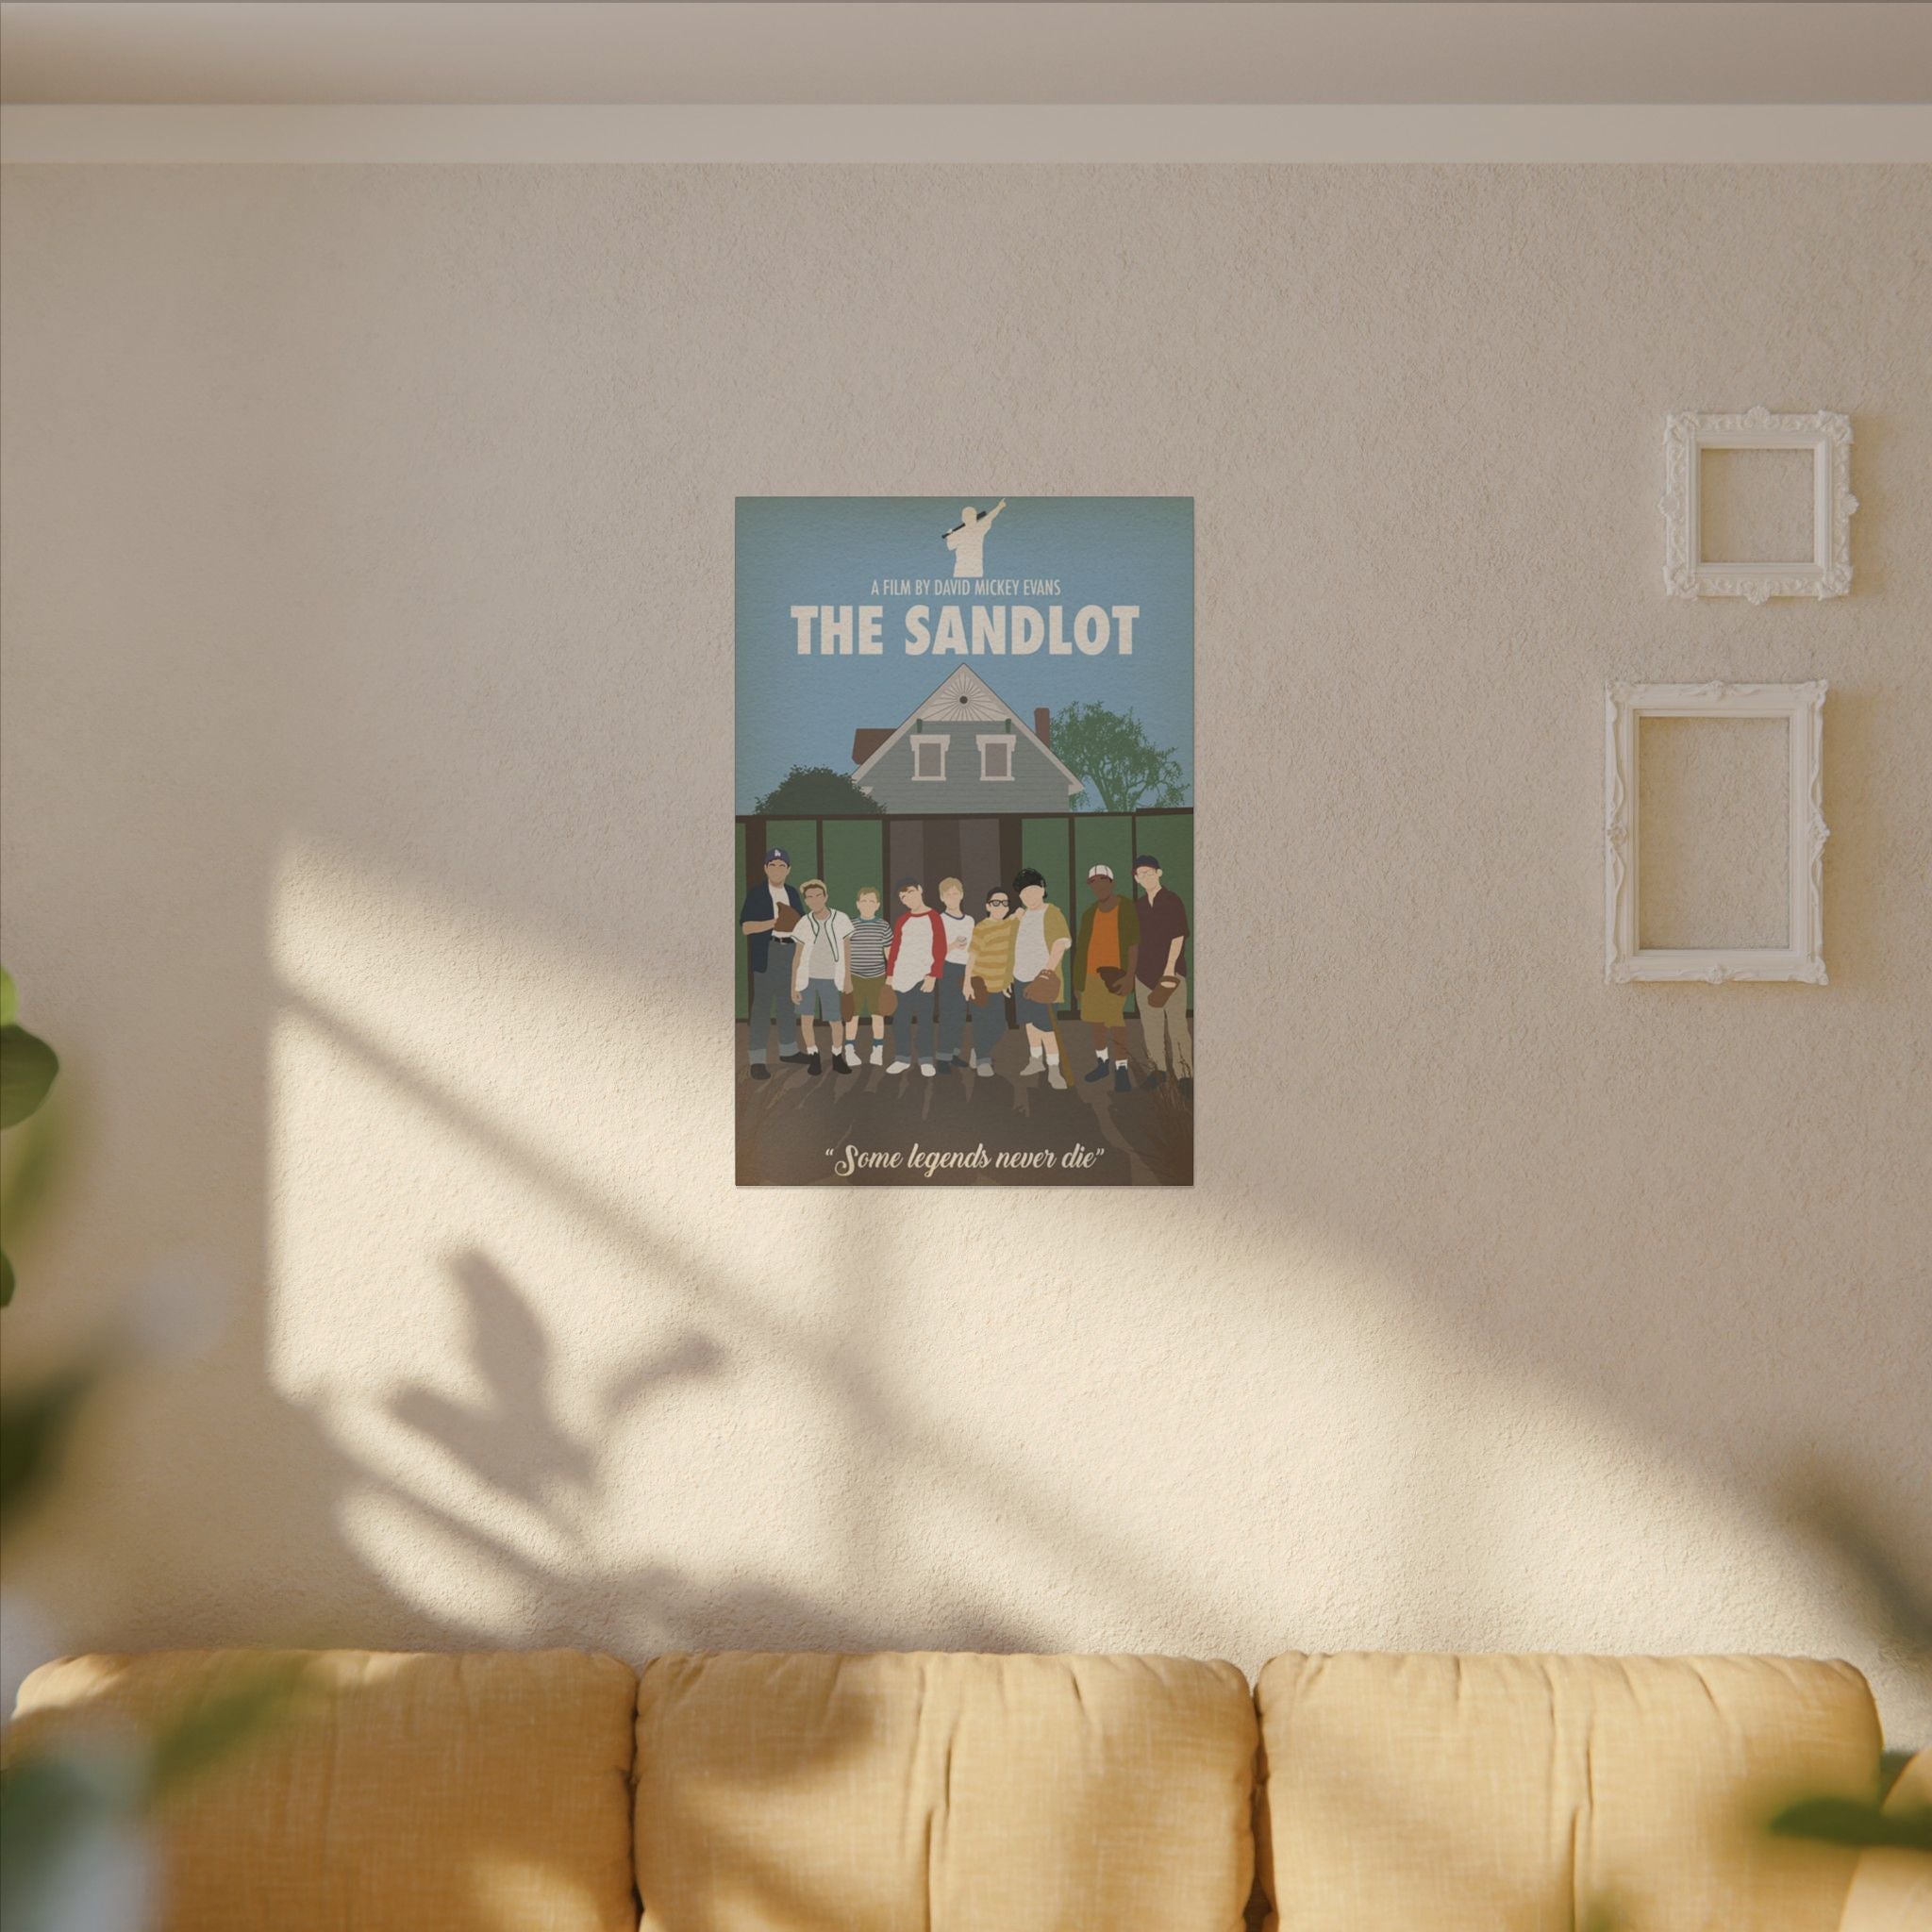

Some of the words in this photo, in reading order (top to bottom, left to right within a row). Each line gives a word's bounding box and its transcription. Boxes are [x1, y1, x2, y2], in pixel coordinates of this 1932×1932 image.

[871, 579, 879, 595] A
[883, 579, 911, 595] FILM
[915, 579, 930, 595] BY
[934, 579, 971, 595] DAVID
[974, 579, 1020, 595] MICKEY
[1024, 579, 1061, 595] EVANS
[791, 605, 884, 655] THE
[905, 604, 1140, 656] SANDLOT
[908, 1142, 991, 1177] legends
[995, 1148, 1056, 1169] never
